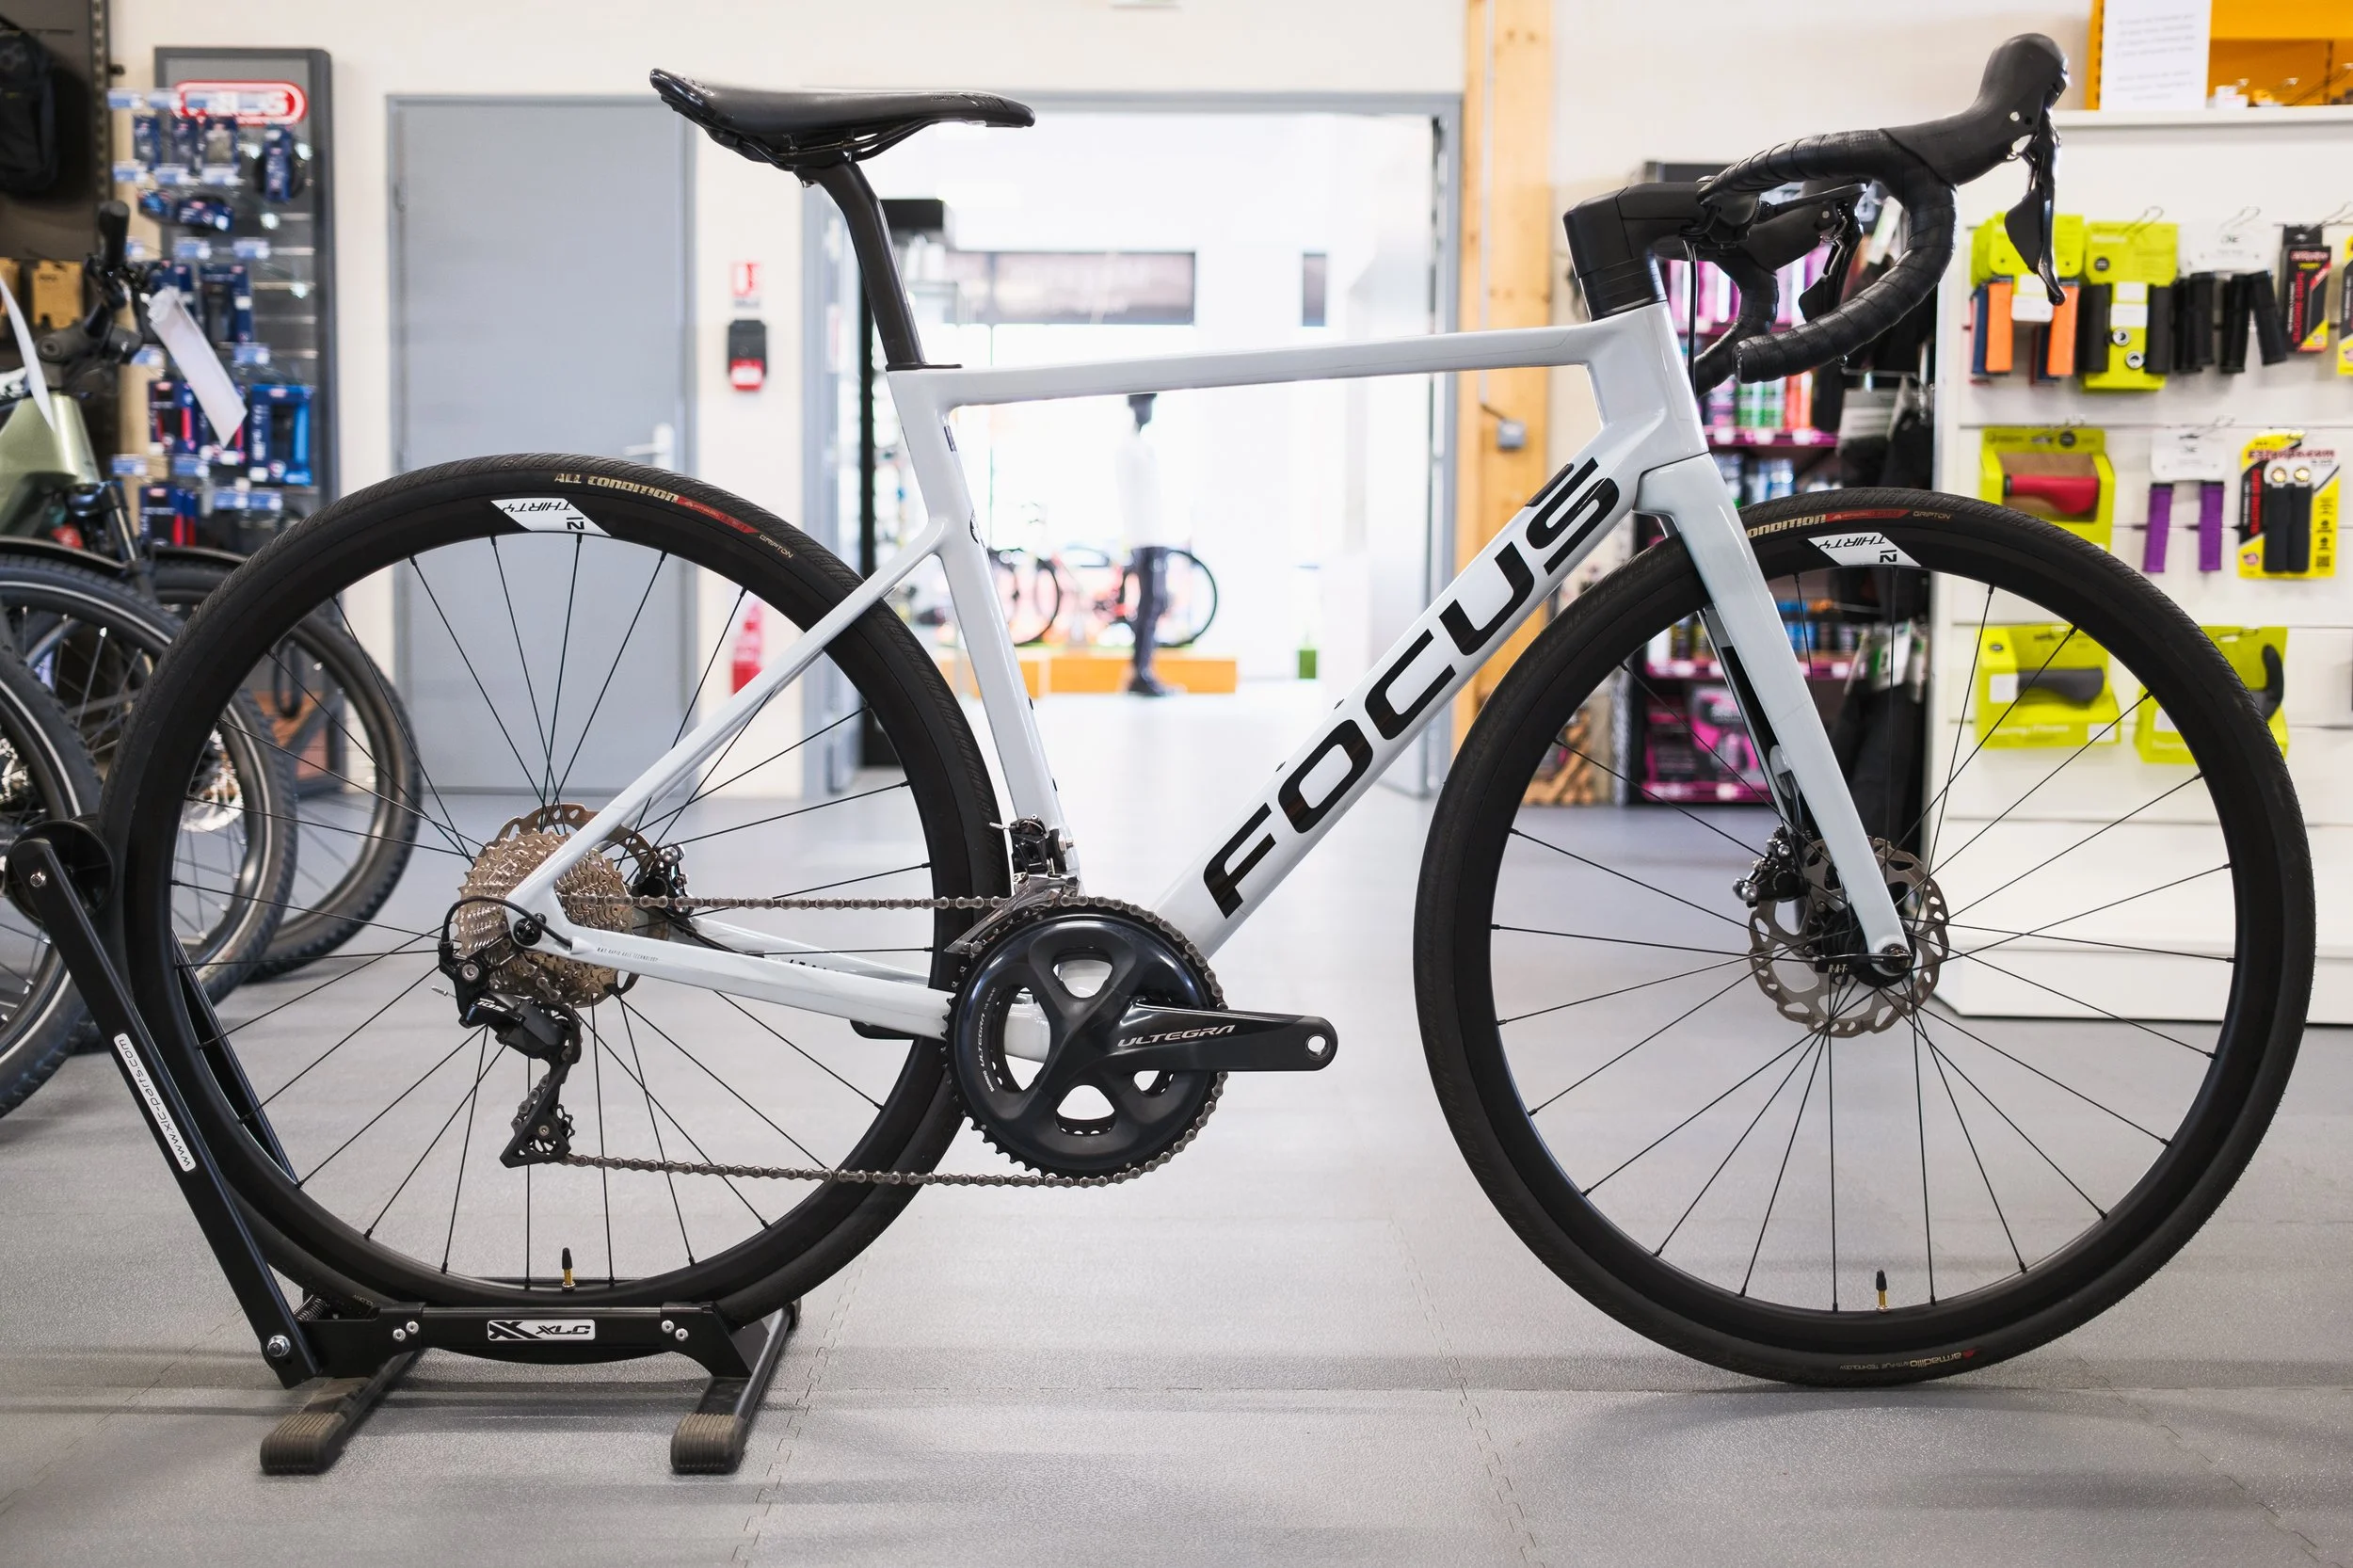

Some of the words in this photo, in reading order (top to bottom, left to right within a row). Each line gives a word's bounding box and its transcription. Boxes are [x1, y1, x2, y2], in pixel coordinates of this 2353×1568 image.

[553, 472, 582, 484] ALL
[503, 502, 570, 512] THIRTY
[1746, 514, 1827, 539] ONDITION
[1913, 510, 1952, 520] GRIPTON
[1817, 536, 1885, 550] THIRTY
[1204, 456, 1620, 919] FOCUS
[1117, 1024, 1236, 1047] ULTEGRA
[119, 1038, 191, 1167] www.xlc-parts.com
[536, 1325, 591, 1335] XLC
[1910, 1352, 1962, 1368] armadillo
